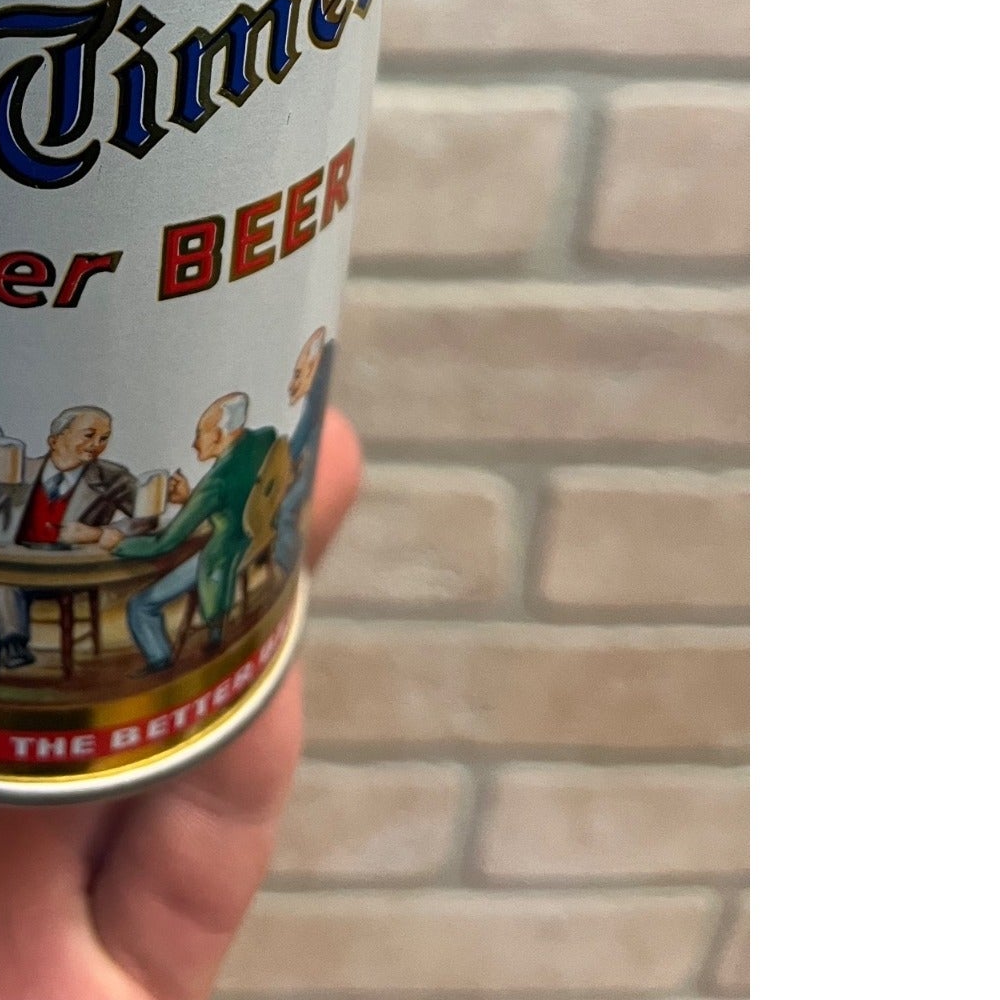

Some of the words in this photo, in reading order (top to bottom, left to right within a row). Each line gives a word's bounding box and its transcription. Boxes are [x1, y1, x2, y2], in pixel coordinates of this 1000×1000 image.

[158, 139, 356, 301] BEER
[9, 735, 98, 758] THE
[110, 661, 256, 749] BETTER
